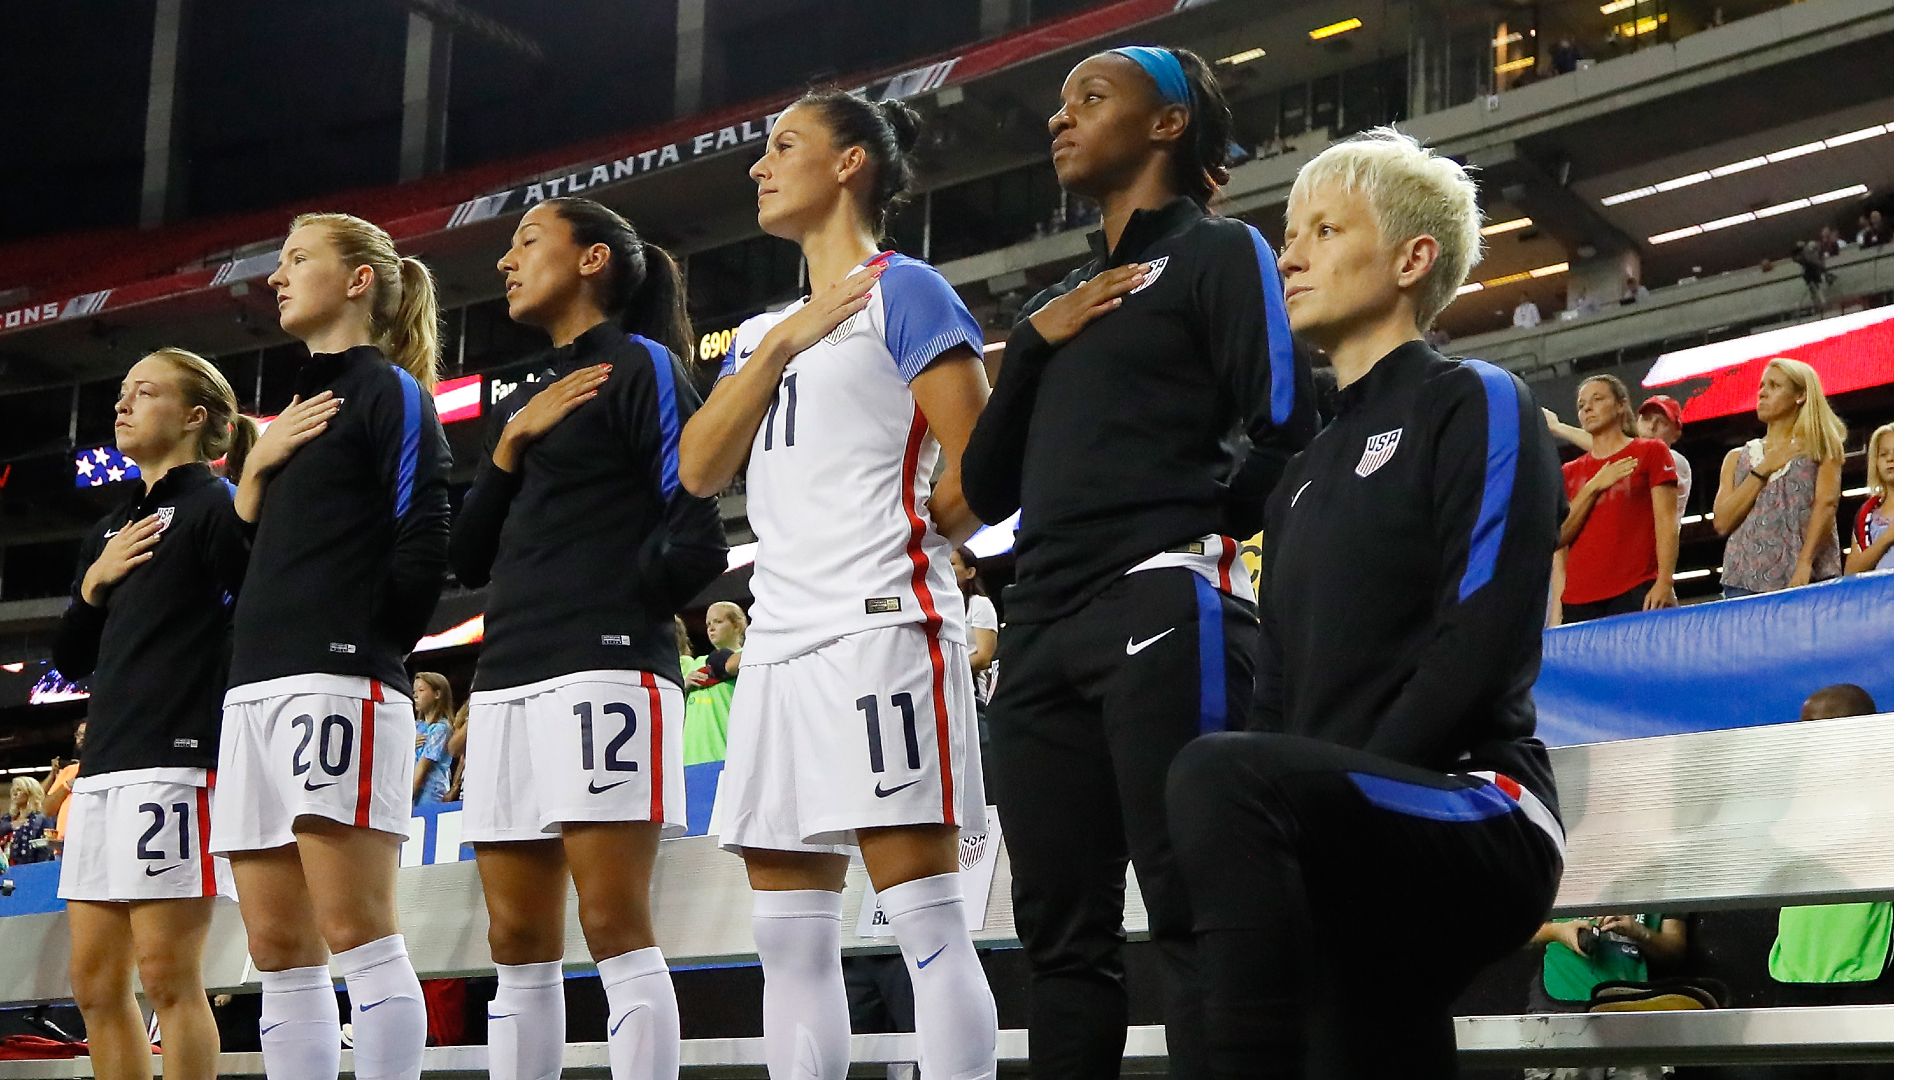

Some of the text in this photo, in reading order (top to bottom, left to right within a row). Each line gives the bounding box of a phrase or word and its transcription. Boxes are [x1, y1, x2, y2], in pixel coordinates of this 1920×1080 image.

[523, 143, 680, 206] ATLANTA
[0, 301, 59, 328] ONS
[764, 372, 798, 451] 11
[1367, 431, 1400, 452] USA
[292, 713, 354, 776] 20
[573, 701, 639, 772] 12
[856, 692, 921, 773] 11
[137, 802, 190, 860] 21
